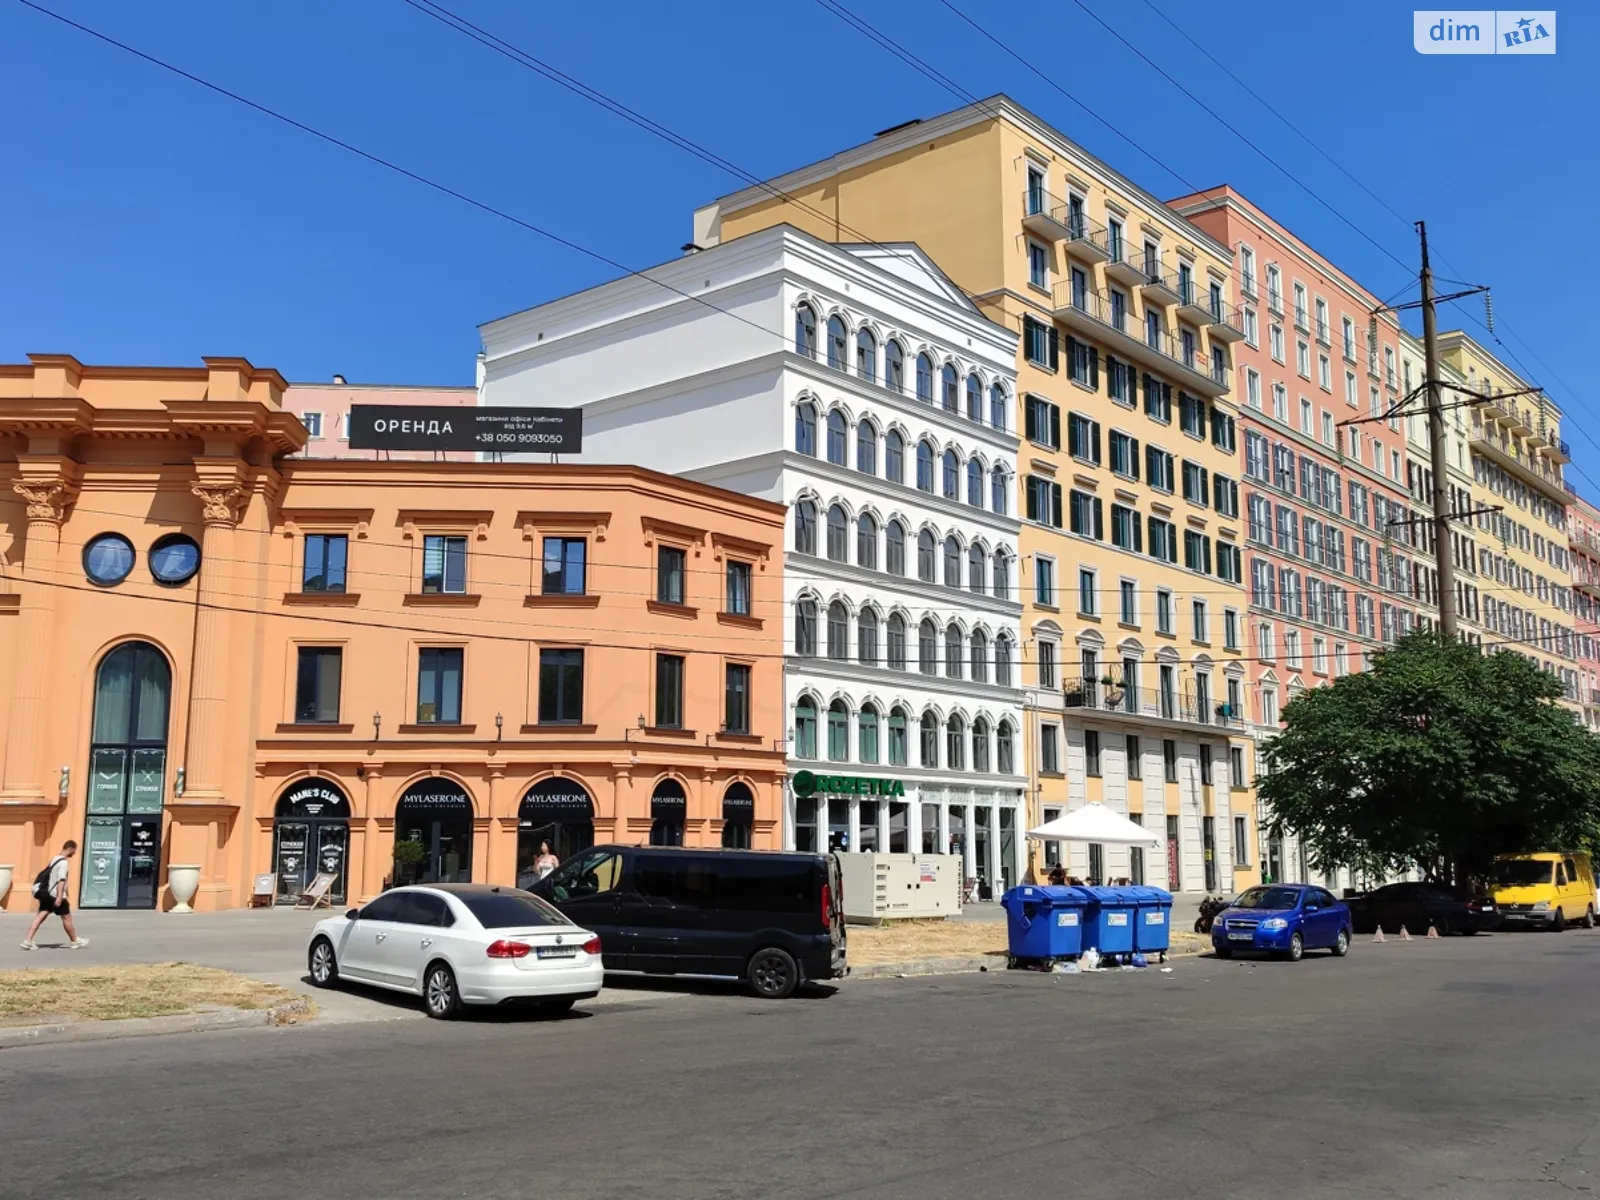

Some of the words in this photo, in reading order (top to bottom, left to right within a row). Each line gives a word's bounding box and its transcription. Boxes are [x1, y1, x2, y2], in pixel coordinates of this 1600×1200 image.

[374, 419, 453, 435] ОРЕНДА
[475, 433, 494, 442] +38
[496, 433, 516, 443] 050
[815, 774, 905, 797] ROZETKA
[404, 794, 466, 803] MYLASERONE
[526, 794, 587, 803] MYLASERONE
